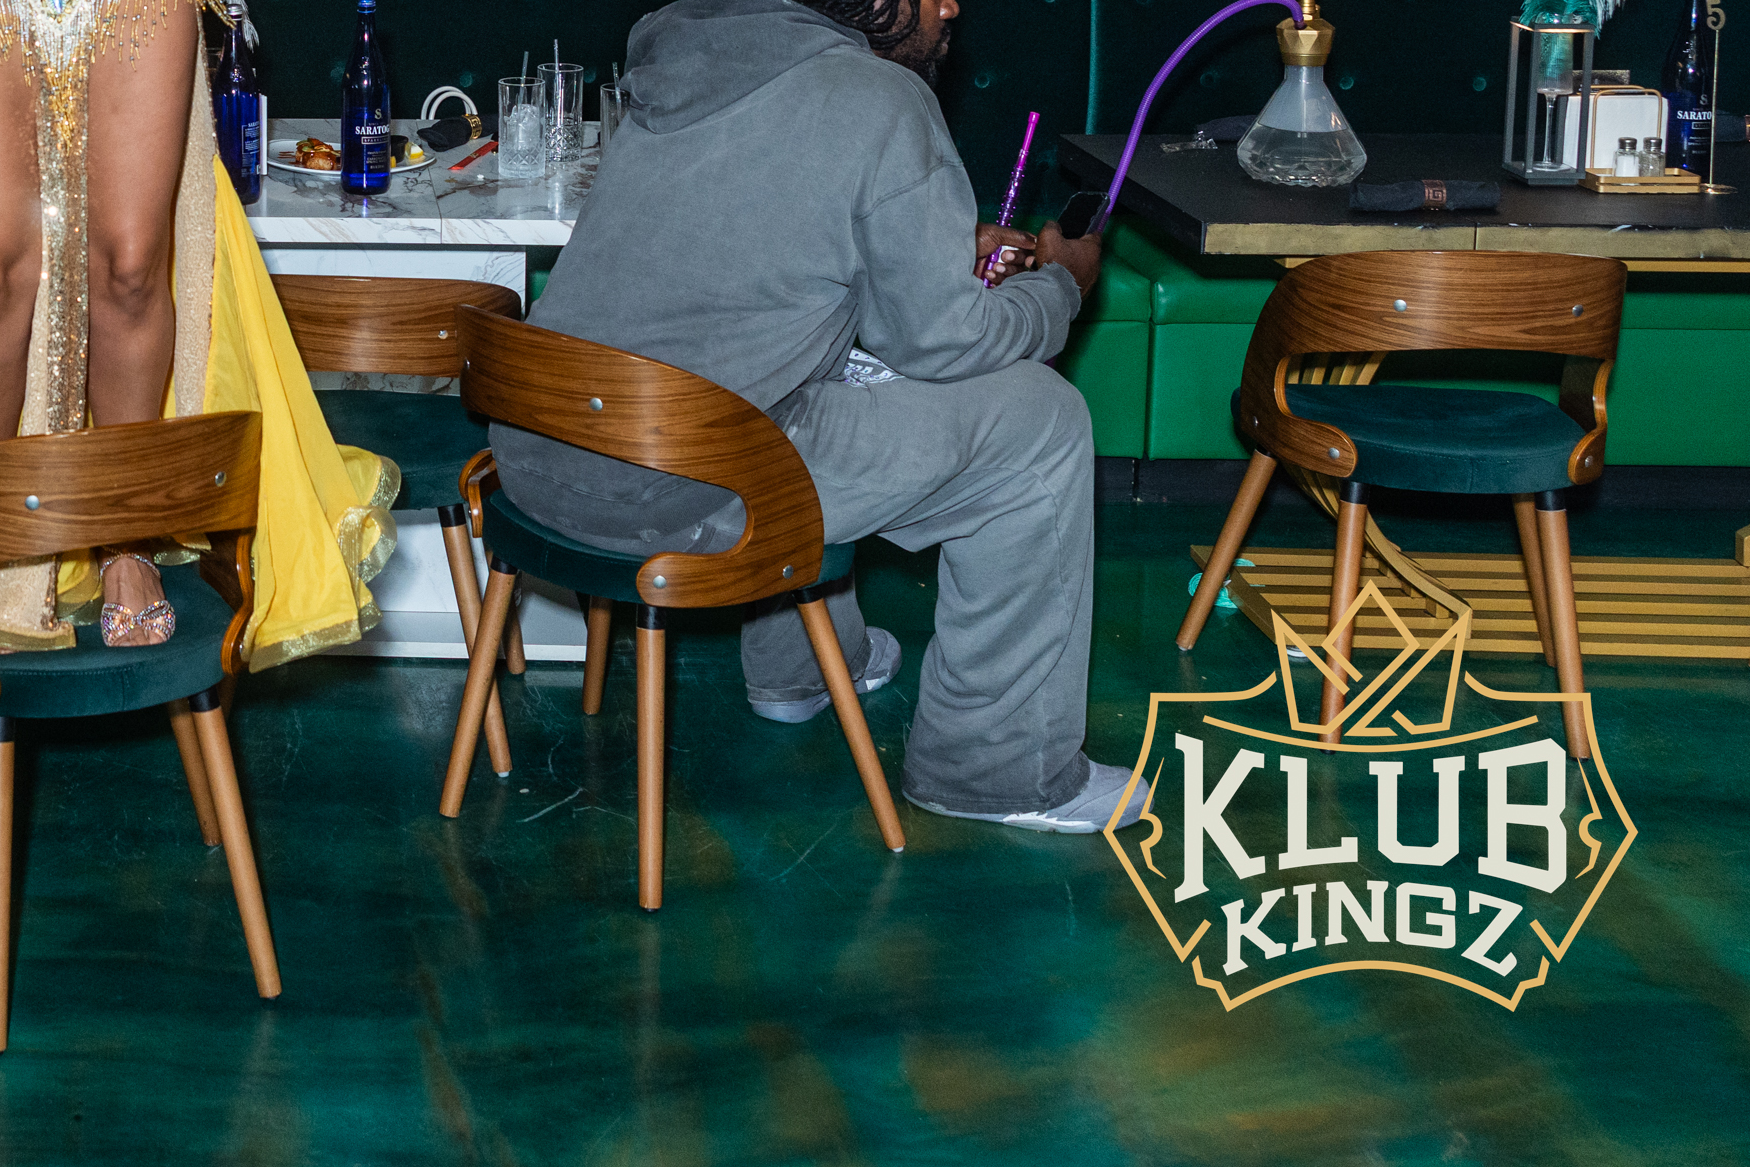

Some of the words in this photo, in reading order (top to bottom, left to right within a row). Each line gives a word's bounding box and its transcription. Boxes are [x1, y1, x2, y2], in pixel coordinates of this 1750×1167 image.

[374, 108, 382, 120] S
[1676, 110, 1713, 120] SARATO
[355, 123, 390, 135] SARATOG
